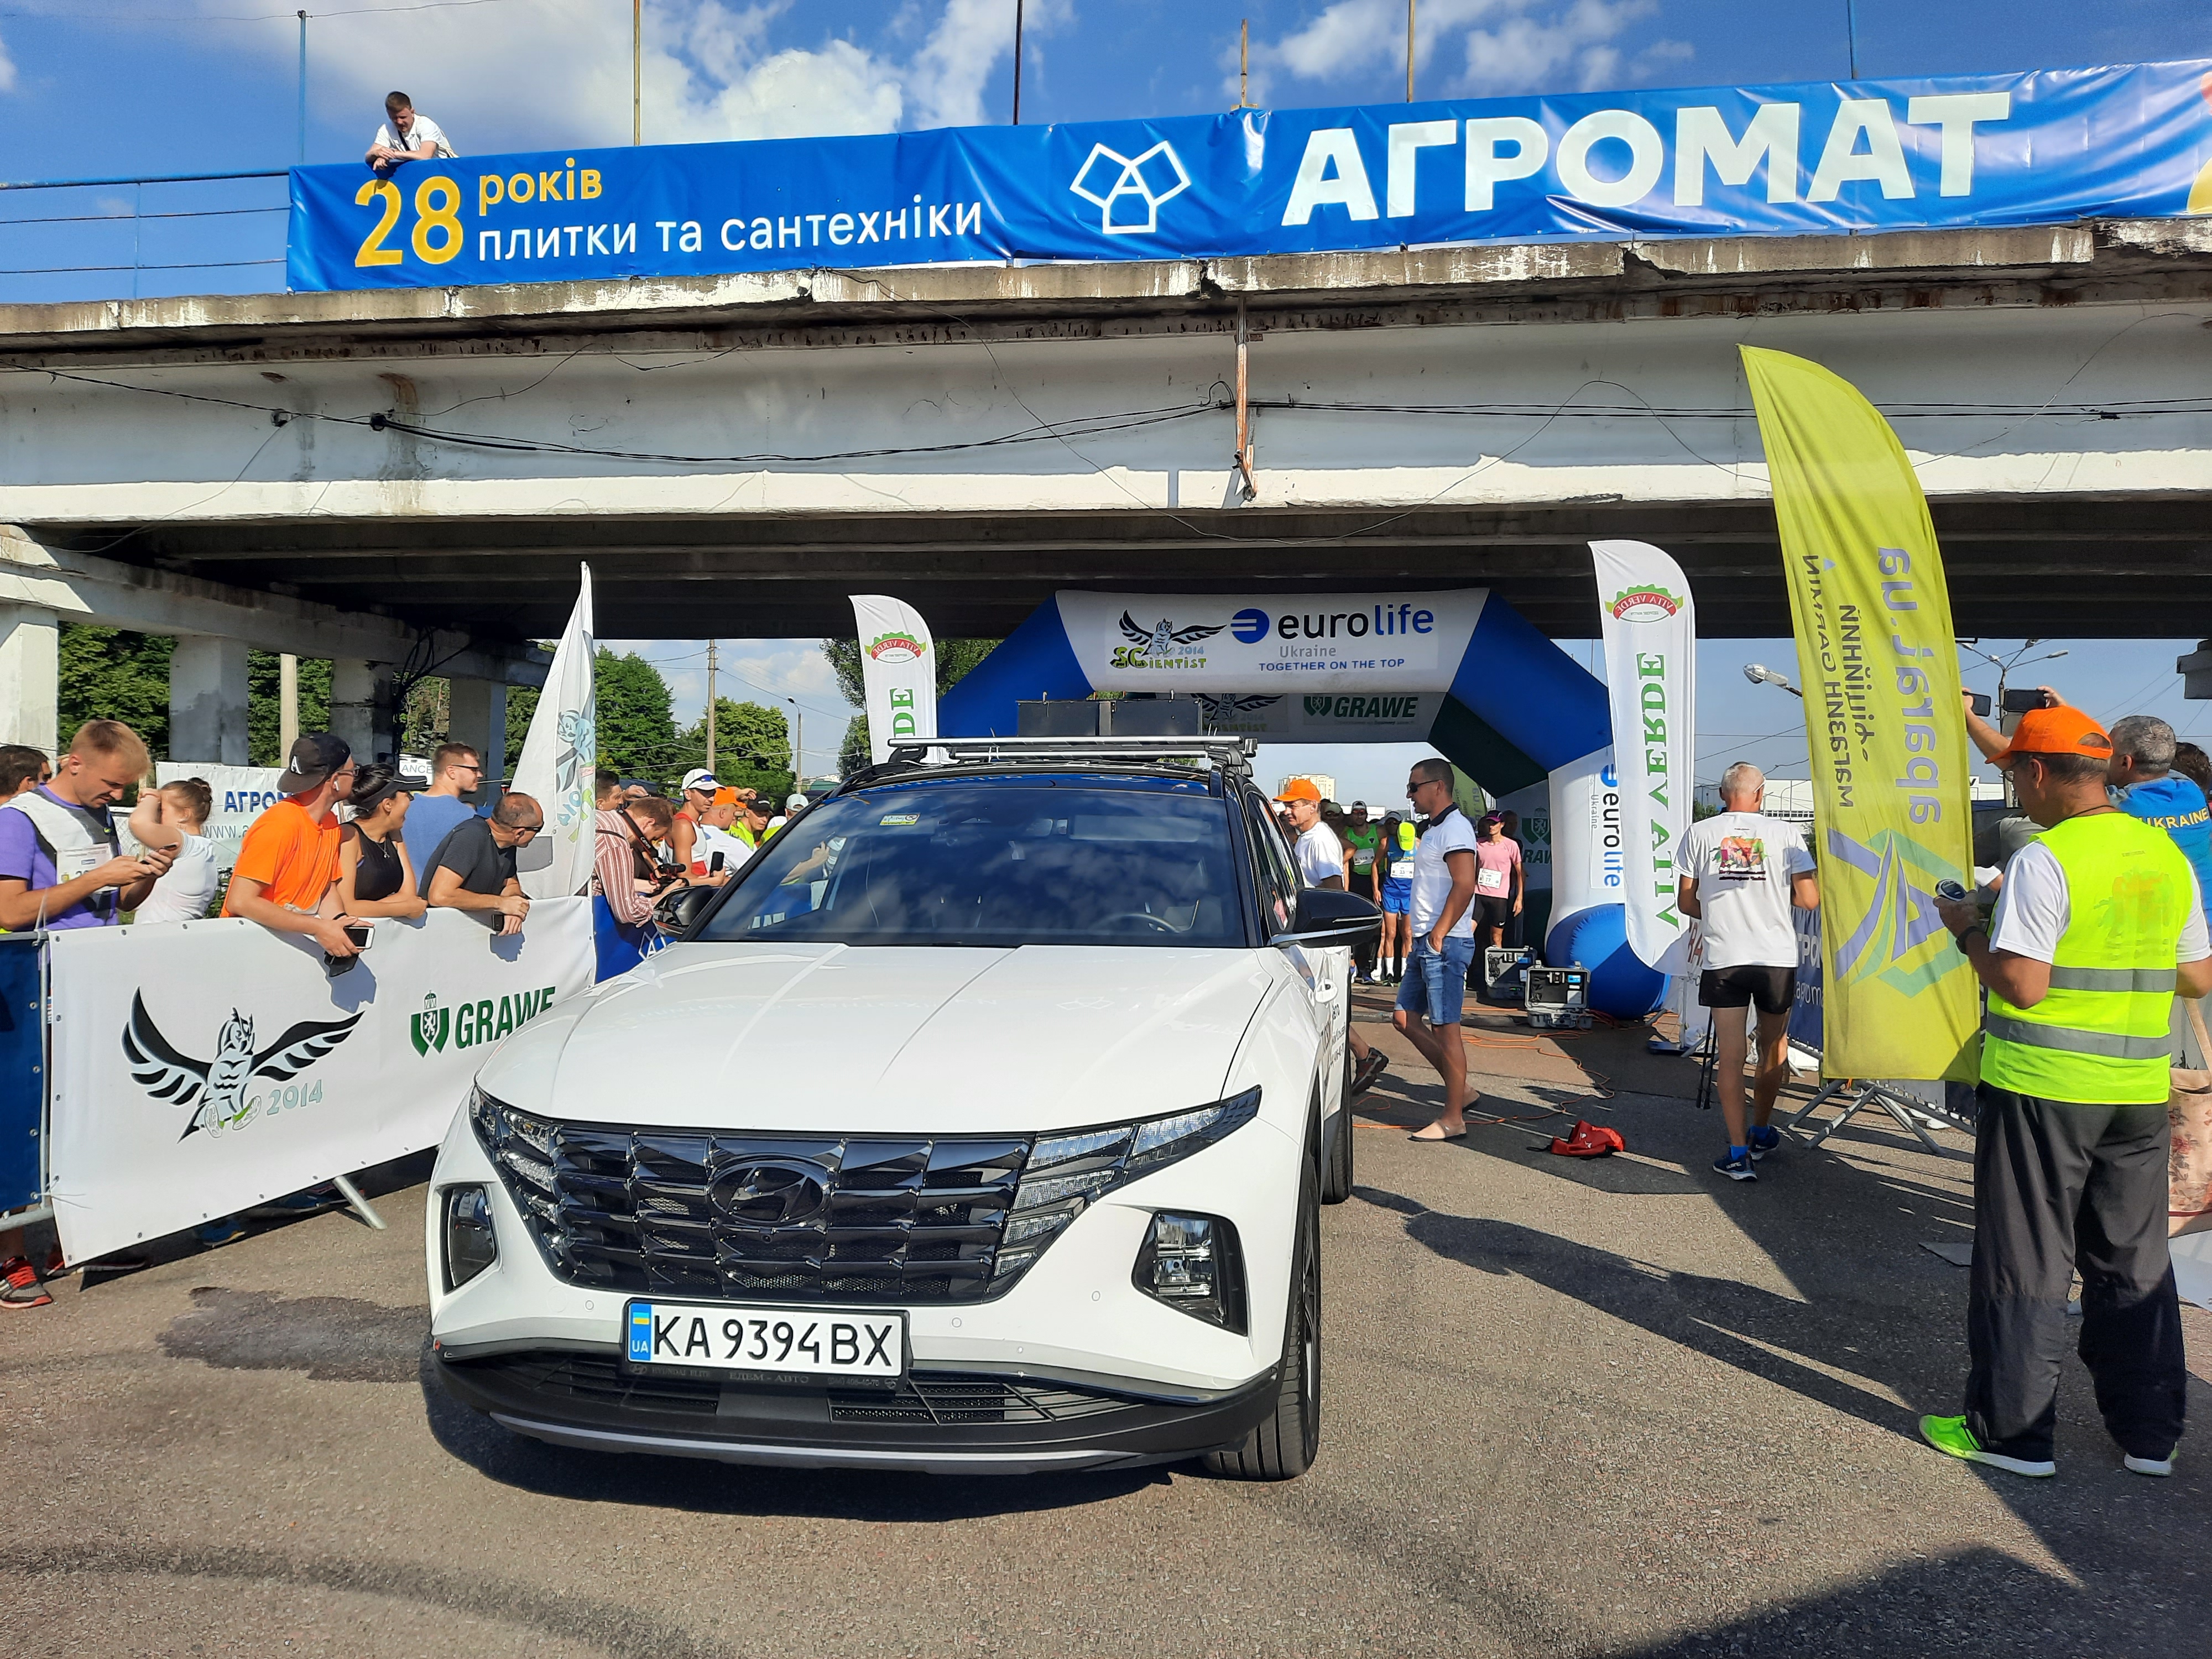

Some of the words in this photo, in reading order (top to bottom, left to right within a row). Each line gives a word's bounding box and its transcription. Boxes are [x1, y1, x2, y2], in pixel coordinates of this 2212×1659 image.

[1281, 91, 2010, 226] АГРОМАТ
[354, 175, 464, 268] 28
[478, 158, 602, 216] років
[478, 222, 636, 261] плитки
[656, 221, 702, 252] та
[720, 195, 981, 251] сантехніки
[1277, 603, 1434, 640] eurolife
[1177, 645, 1204, 656] 2014
[1259, 661, 1326, 671] TOGETHER
[1330, 660, 1349, 670] ON
[1352, 659, 1376, 670] THE
[1379, 658, 1405, 669] TOP
[1279, 644, 1337, 659] Ukraine
[1333, 696, 1418, 719] GRAWE
[1590, 794, 1600, 830] Ukraine
[1603, 792, 1624, 888] eurolife
[455, 986, 556, 1049] GRAWE
[266, 1079, 323, 1116] 2014
[632, 1339, 649, 1354] UA
[654, 1314, 712, 1359] KA
[722, 1318, 820, 1364] 9394
[831, 1322, 893, 1366] BX
